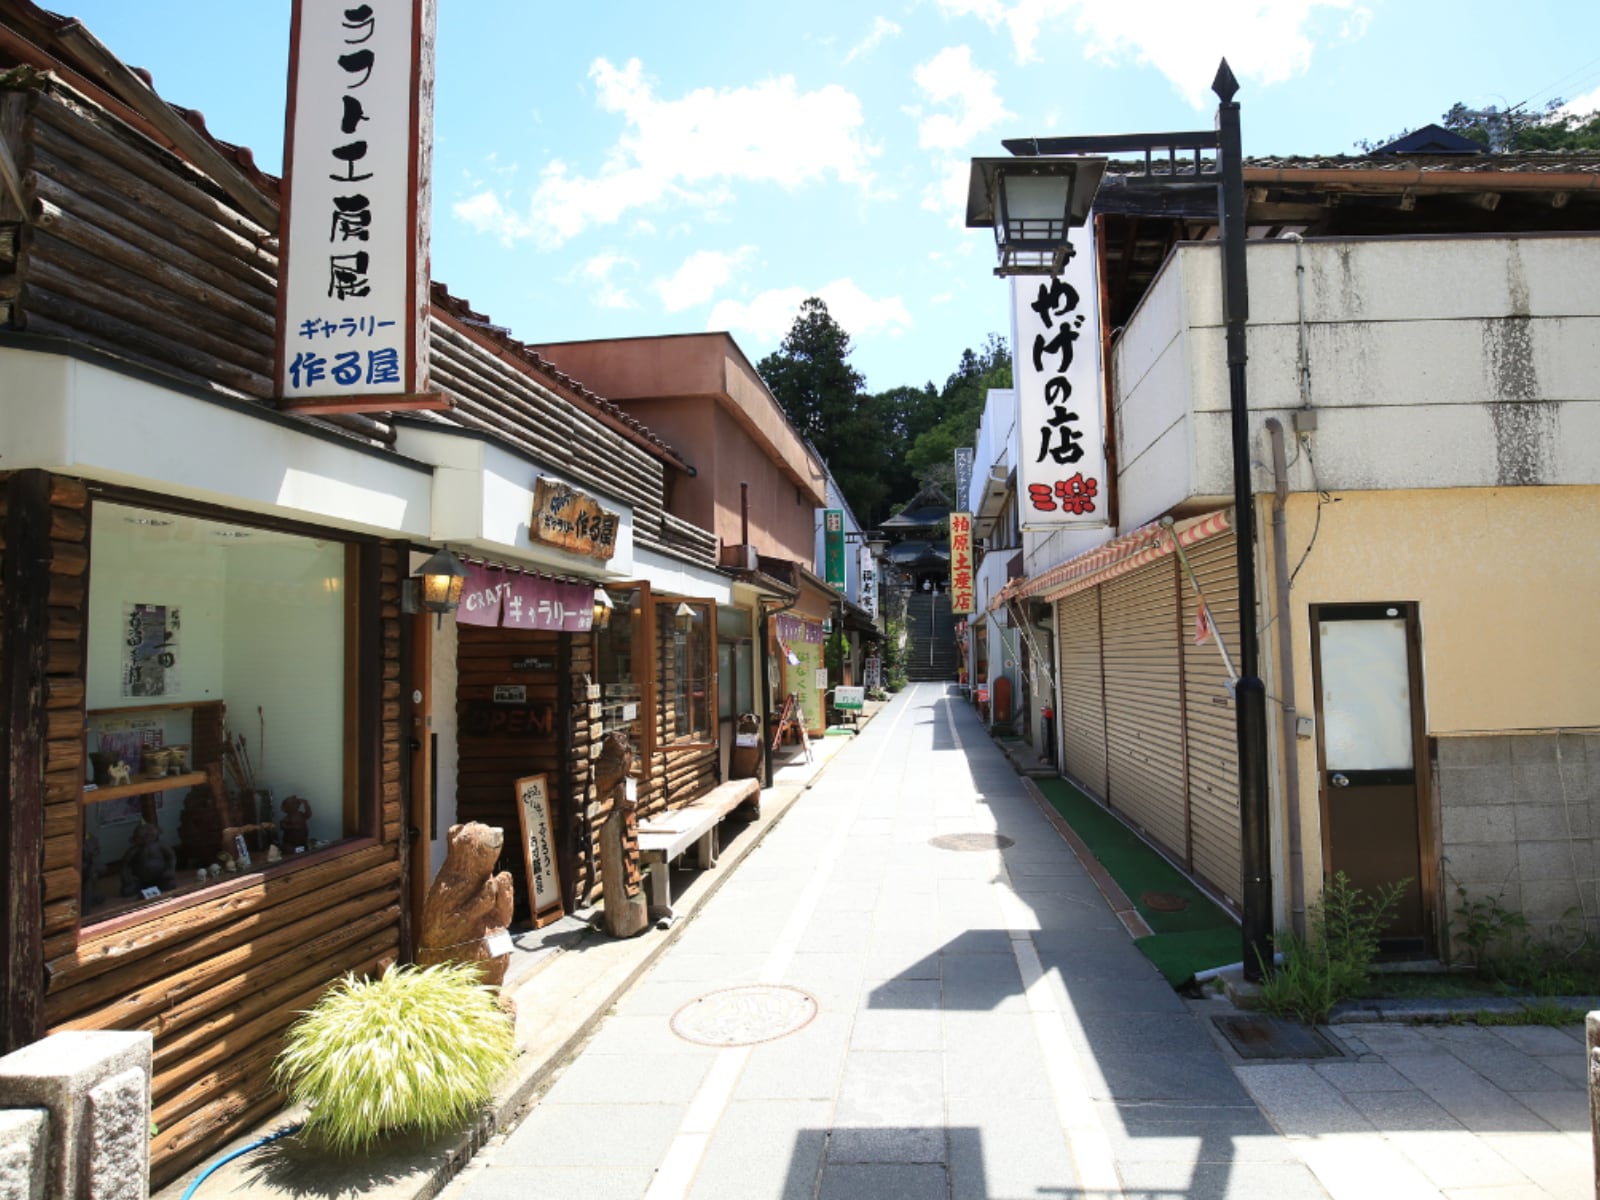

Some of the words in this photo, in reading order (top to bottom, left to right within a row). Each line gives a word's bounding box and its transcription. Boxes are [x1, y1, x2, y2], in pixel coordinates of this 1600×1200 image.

[299, 317, 396, 340] ギャラリー
[289, 348, 401, 388] 作る屋
[1031, 246, 1086, 466] やげの店
[576, 509, 615, 545] 作る屋
[952, 515, 973, 610] 柏原土産店
[466, 582, 512, 612] CRAFT
[509, 595, 577, 625] ギャラリー
